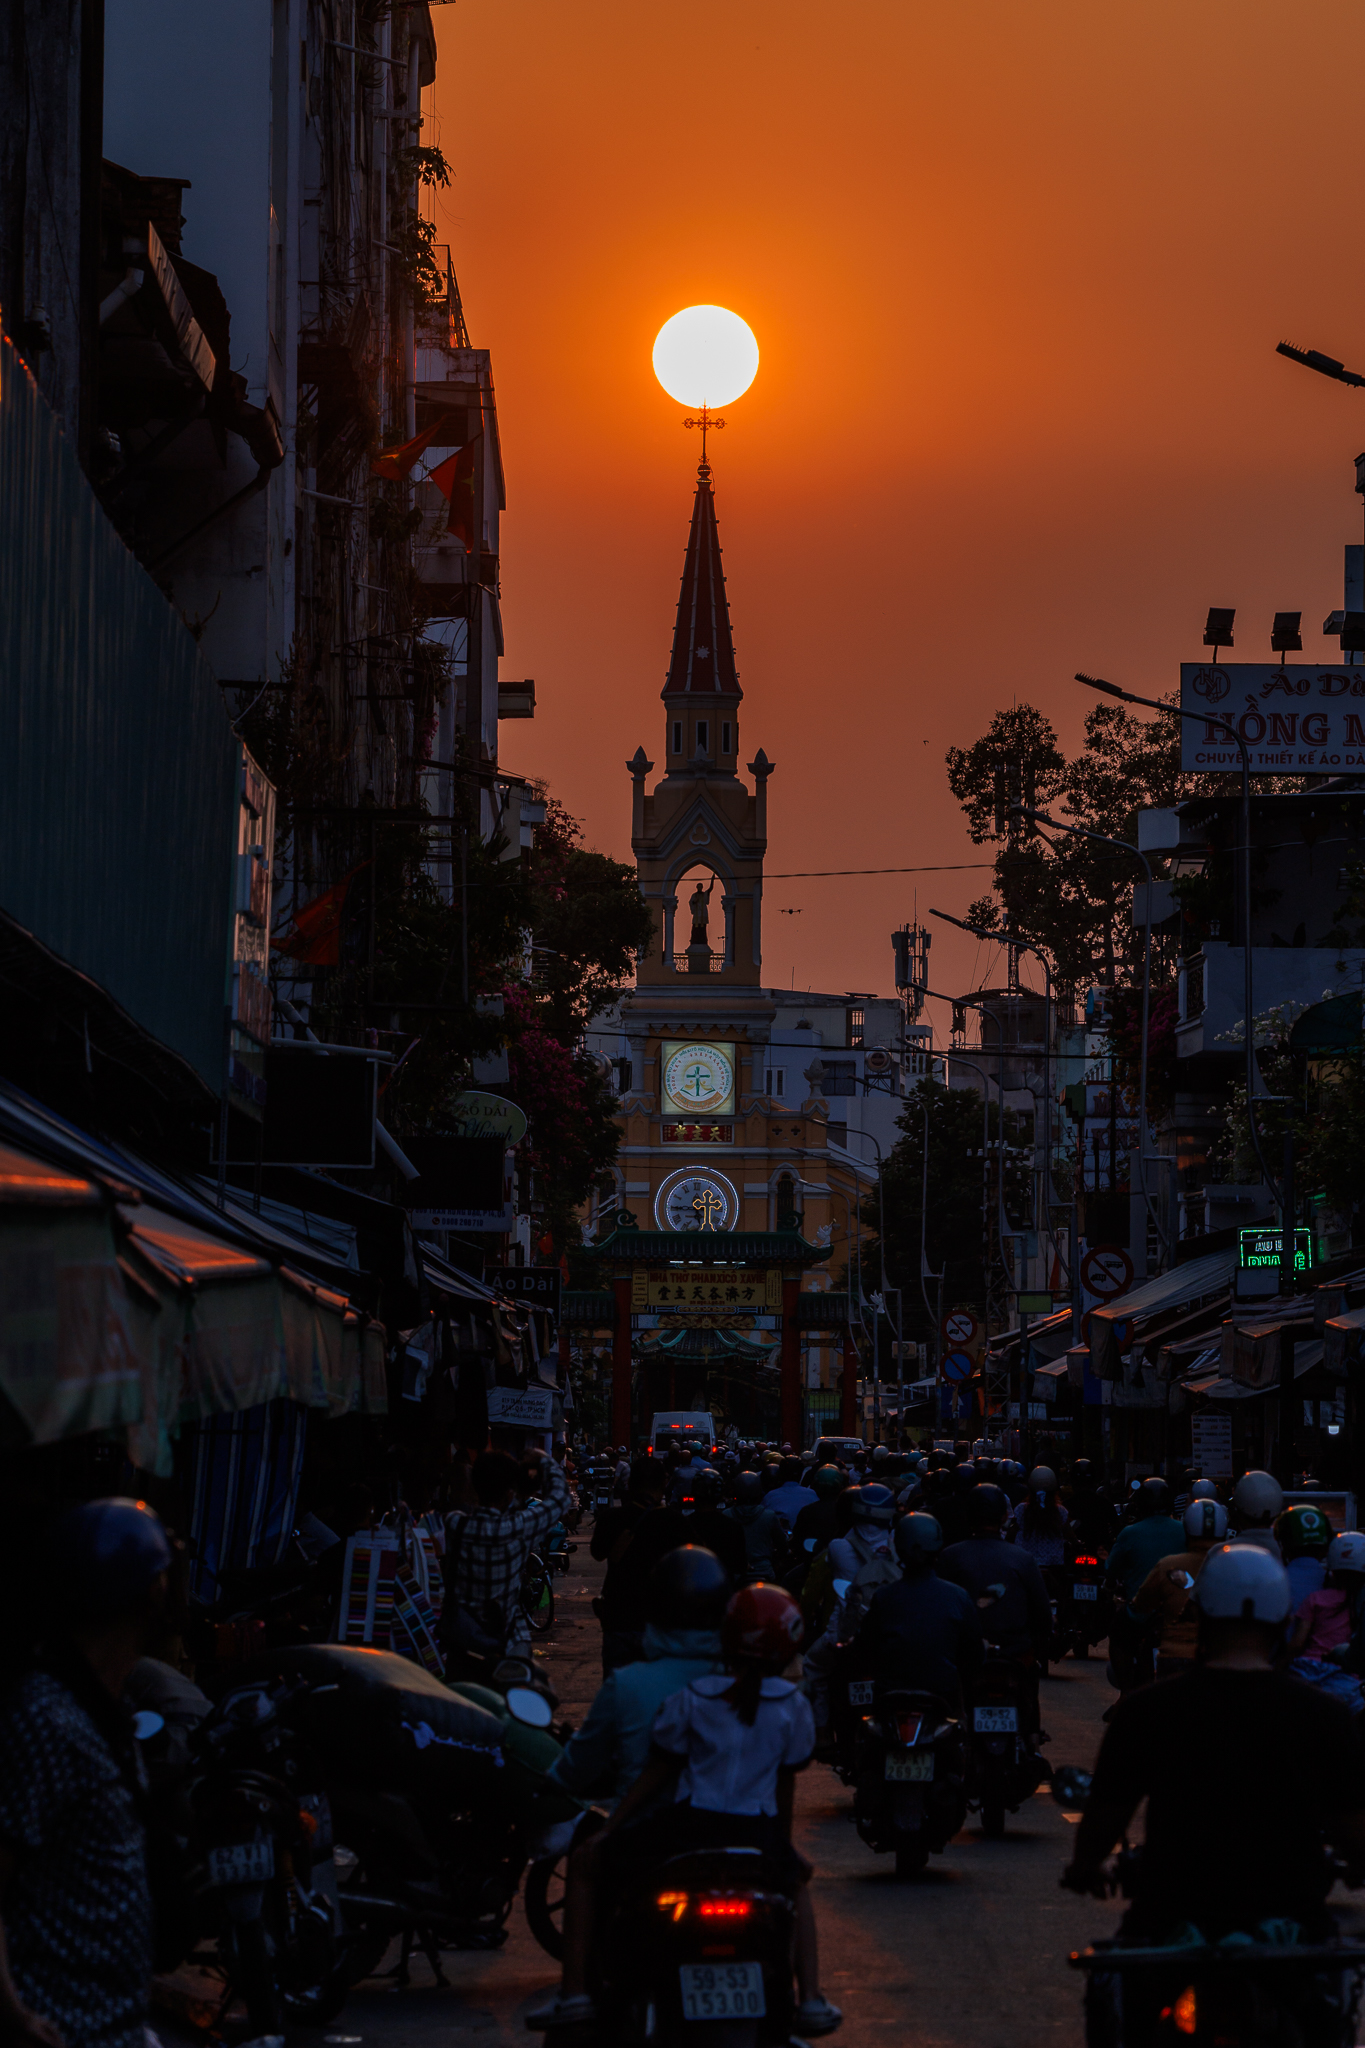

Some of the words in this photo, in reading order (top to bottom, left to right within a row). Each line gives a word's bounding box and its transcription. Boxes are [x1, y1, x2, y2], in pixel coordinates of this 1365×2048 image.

[1259, 667, 1311, 698] Áo
[1202, 694, 1331, 747] HỒNG
[1258, 749, 1294, 764] THIẾT
[1298, 749, 1318, 764] KẾ
[1319, 751, 1341, 765] ÁO
[484, 1105, 507, 1117] DÀI
[492, 1272, 517, 1291] Áo
[522, 1273, 554, 1291] Dài
[692, 1967, 749, 1990] 59-S3
[687, 1991, 758, 2015] 153.00
